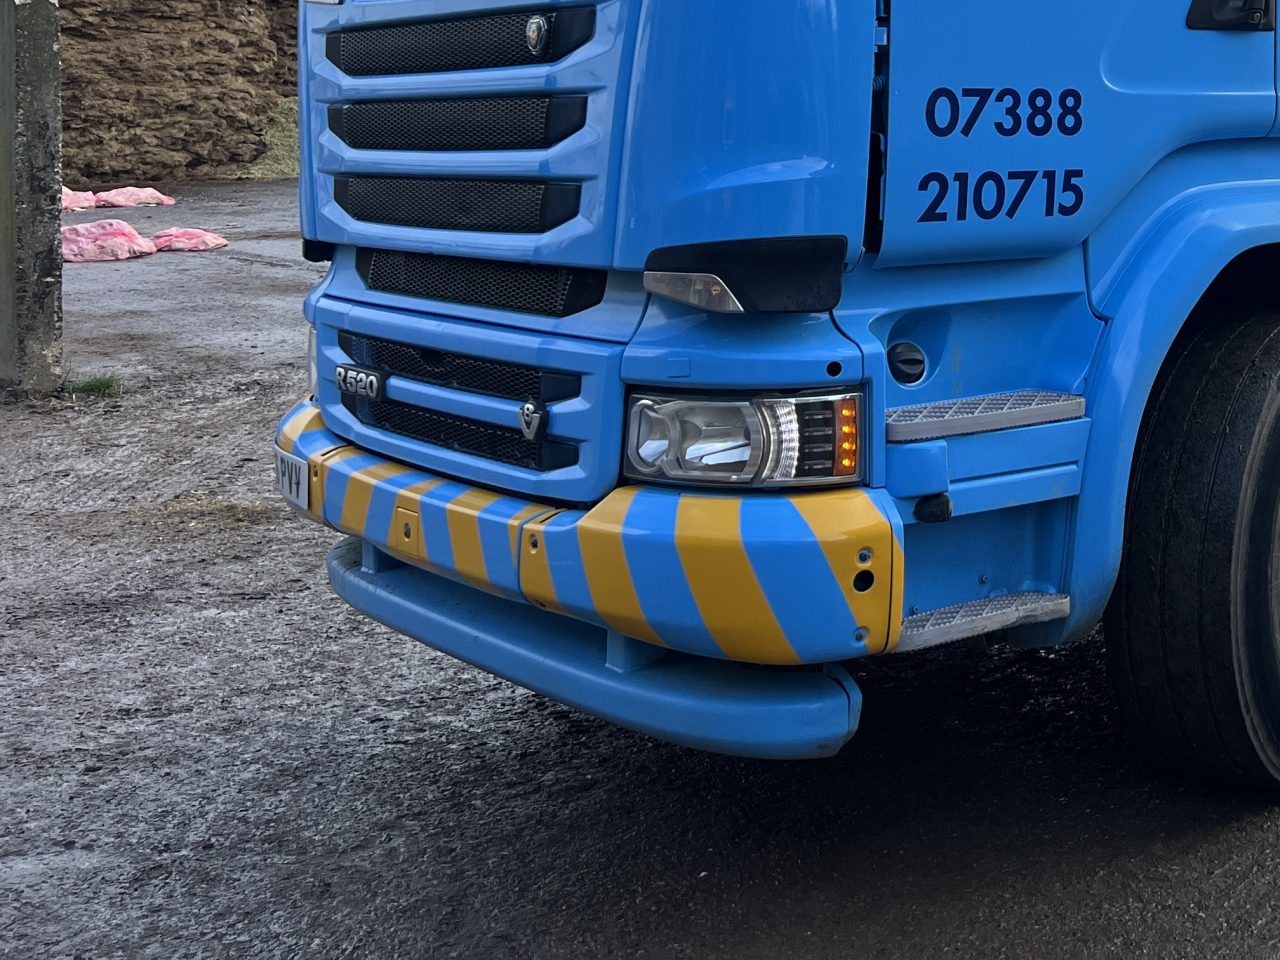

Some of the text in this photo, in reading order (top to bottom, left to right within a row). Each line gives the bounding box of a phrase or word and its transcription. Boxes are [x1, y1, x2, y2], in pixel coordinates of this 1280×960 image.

[925, 86, 1083, 138] 07388
[917, 169, 1084, 223] 210715
[280, 456, 301, 499] PVY
